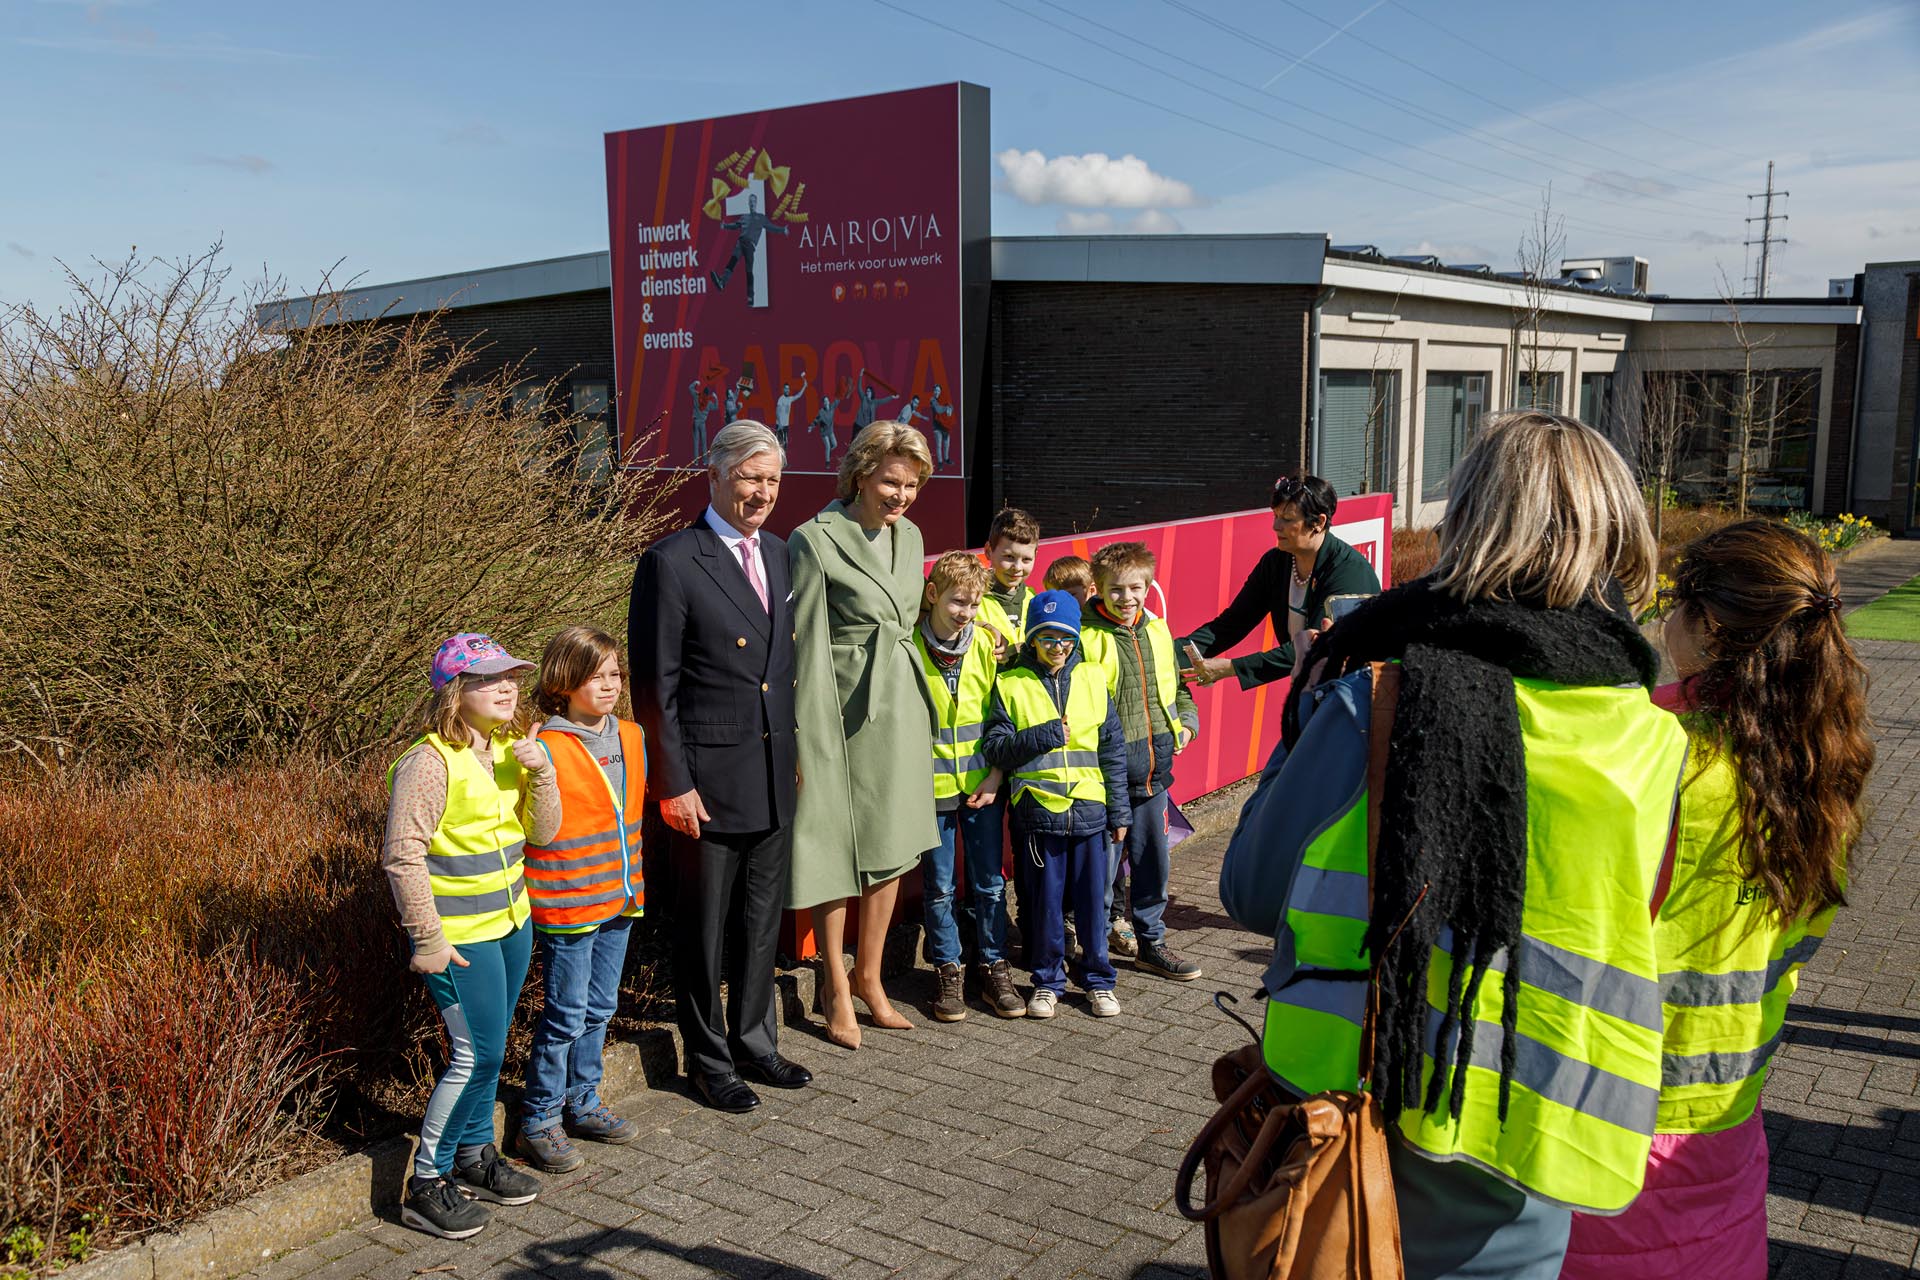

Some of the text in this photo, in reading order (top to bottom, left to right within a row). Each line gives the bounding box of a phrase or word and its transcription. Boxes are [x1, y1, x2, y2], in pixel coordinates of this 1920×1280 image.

[638, 219, 691, 243] inwerk
[640, 246, 699, 270] uitwerk
[800, 252, 943, 274] Het merk voor uw werk
[641, 274, 707, 297] diensten
[642, 303, 654, 323] &
[643, 328, 693, 350] events
